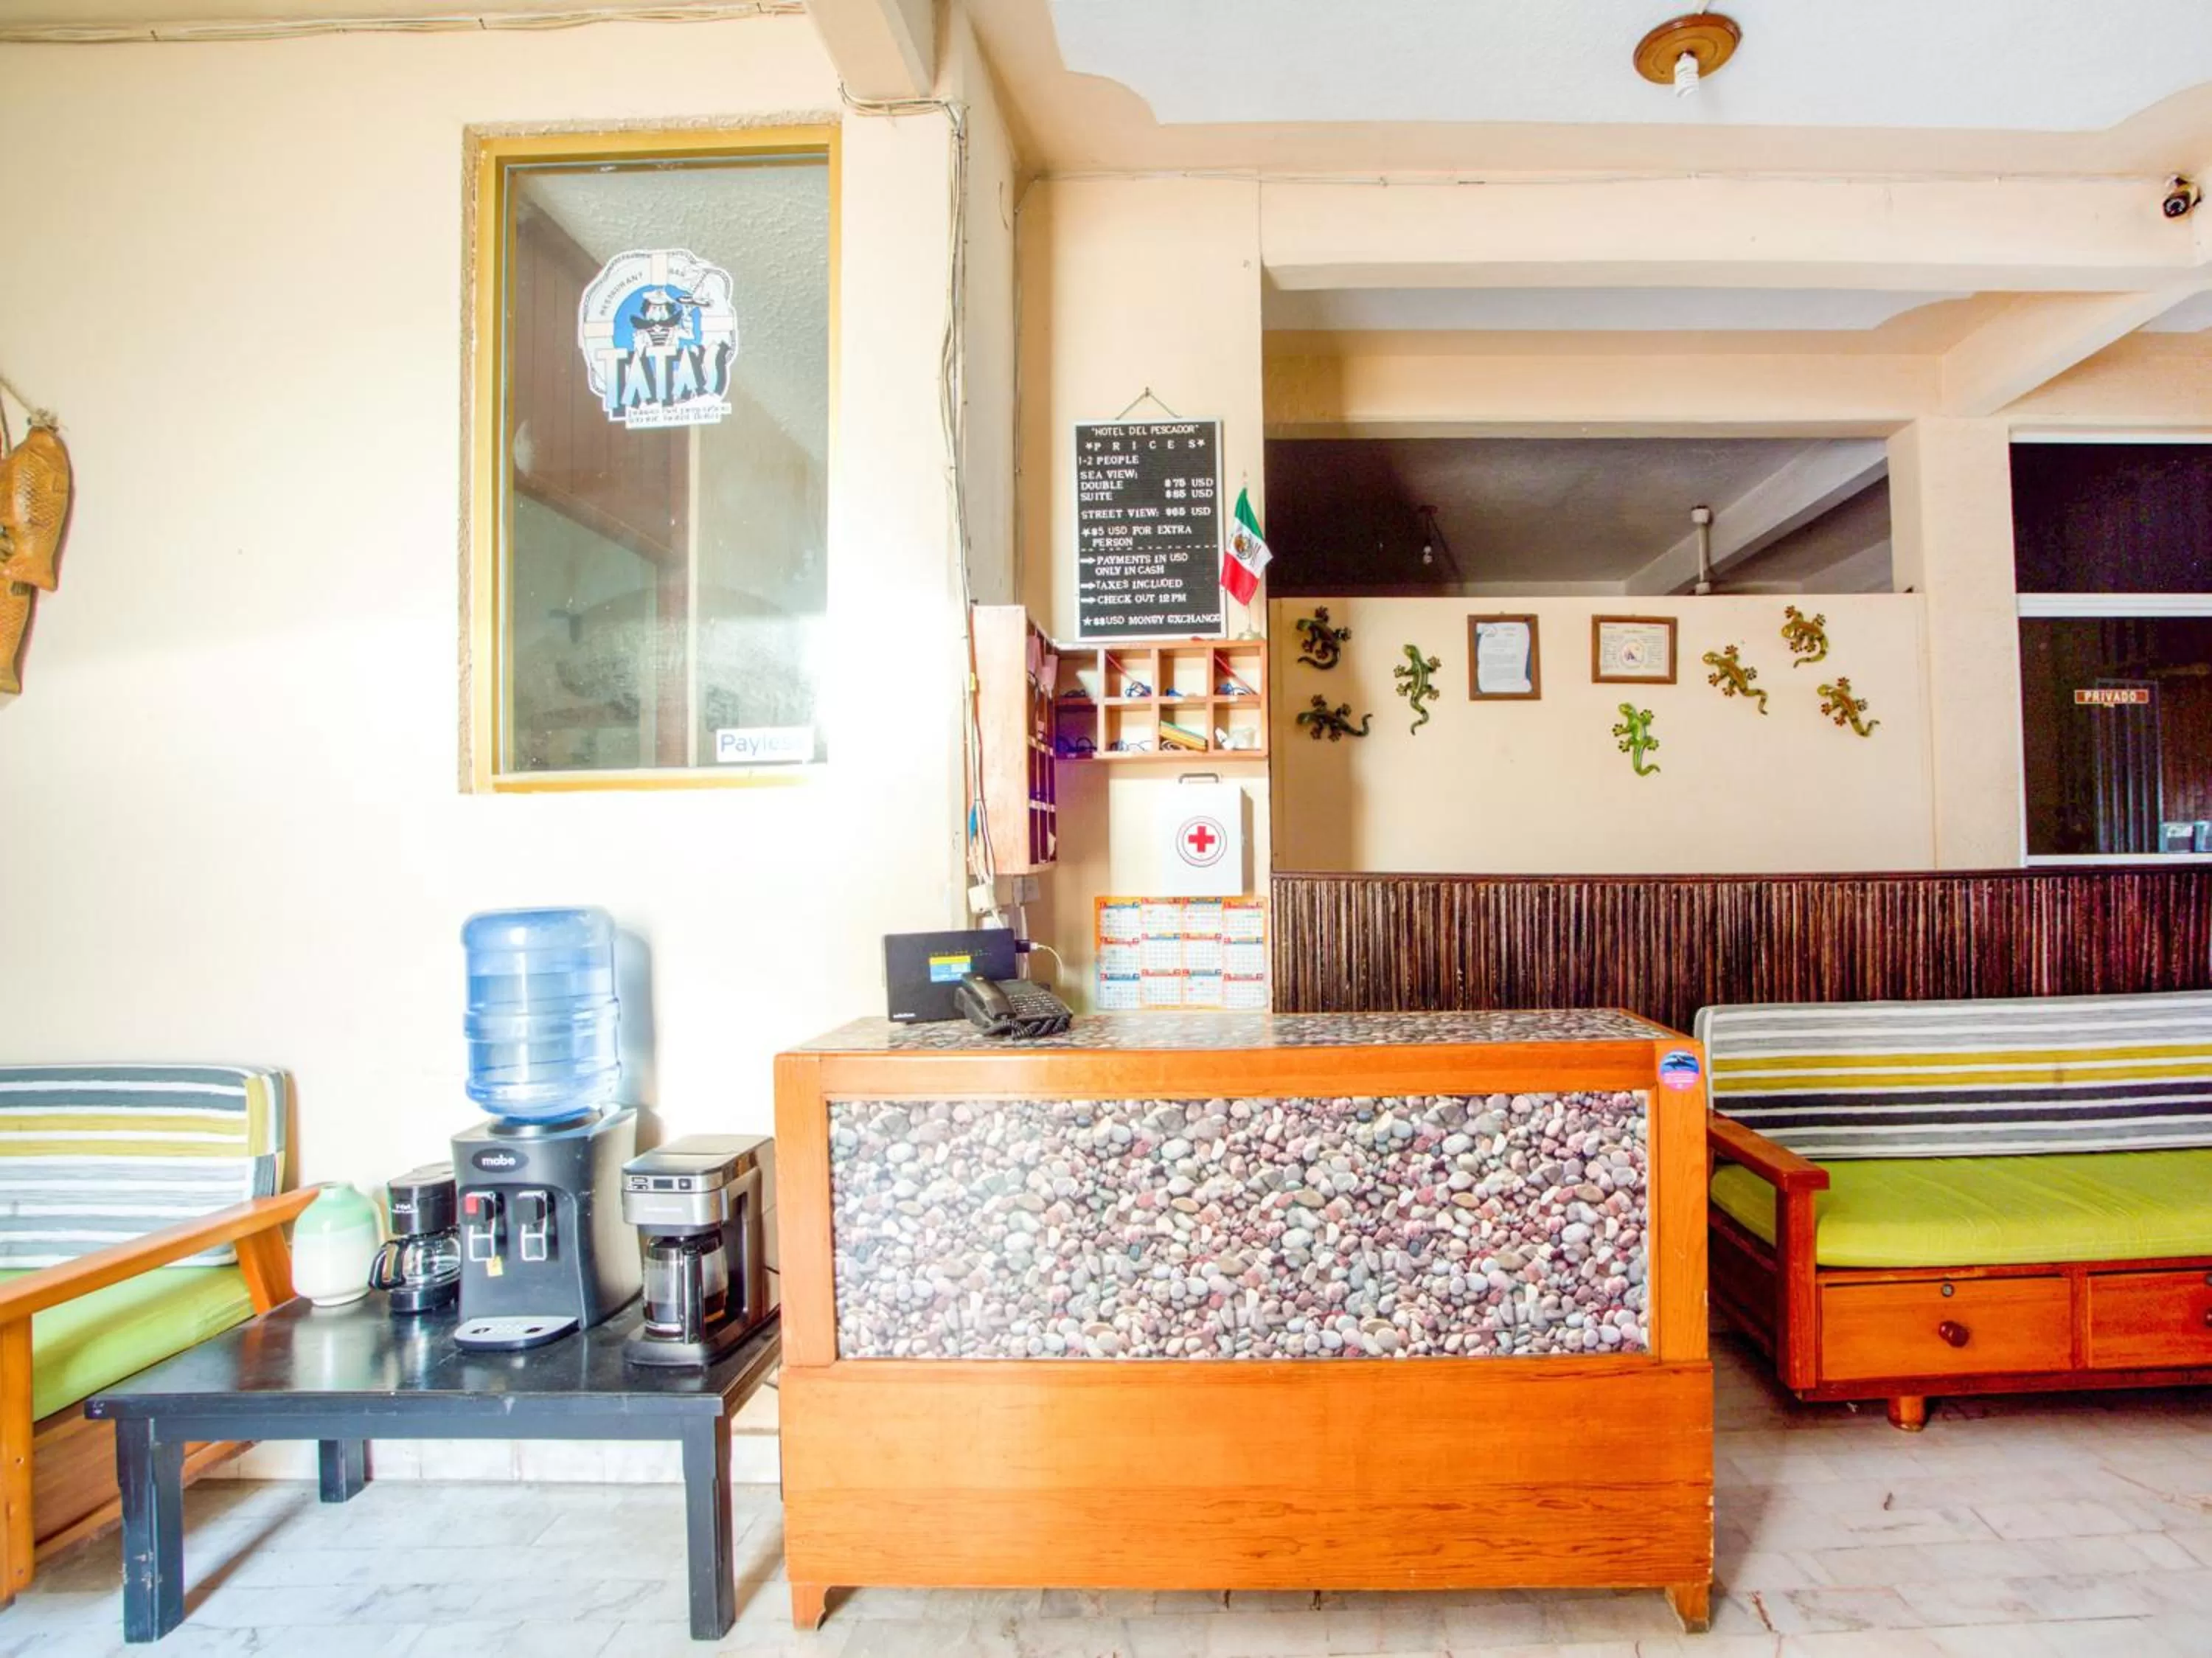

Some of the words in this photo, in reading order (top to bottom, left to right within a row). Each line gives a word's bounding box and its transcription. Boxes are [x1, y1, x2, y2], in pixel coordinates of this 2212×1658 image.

[596, 343, 726, 411] TATAS
[1129, 426, 1147, 436] DEL
[1096, 455, 1139, 465] PEOPLE
[1080, 470, 1102, 479] SEA
[1080, 481, 1124, 490] DOUBLE
[1192, 479, 1214, 488] USD
[1080, 492, 1113, 502] SUITE
[1192, 489, 1214, 498] USD
[1081, 509, 1123, 520] STREET
[1191, 507, 1211, 516] USD
[1108, 526, 1127, 535] USD
[1133, 526, 1152, 536] FOR
[1158, 525, 1192, 535] EXTRA
[1092, 537, 1133, 547] PERSON
[1096, 554, 1151, 566] PAYMENTS
[1154, 554, 1167, 563] IN
[1169, 552, 1189, 562] USD
[1095, 566, 1121, 576] ONLY
[1124, 566, 1136, 575] IN
[1138, 565, 1165, 575] CASH
[1096, 580, 1129, 590] TAXES
[1132, 579, 1183, 589] INCLUDED
[1096, 594, 1132, 605] CHECK
[1135, 594, 1155, 603] OUT
[1171, 593, 1187, 603] PM
[1128, 614, 1165, 625] MONEY
[1167, 613, 1221, 624] EXCHANGE
[2084, 690, 2136, 703] PRIVADO
[720, 731, 804, 756] Payles
[481, 1154, 516, 1166] mabe
